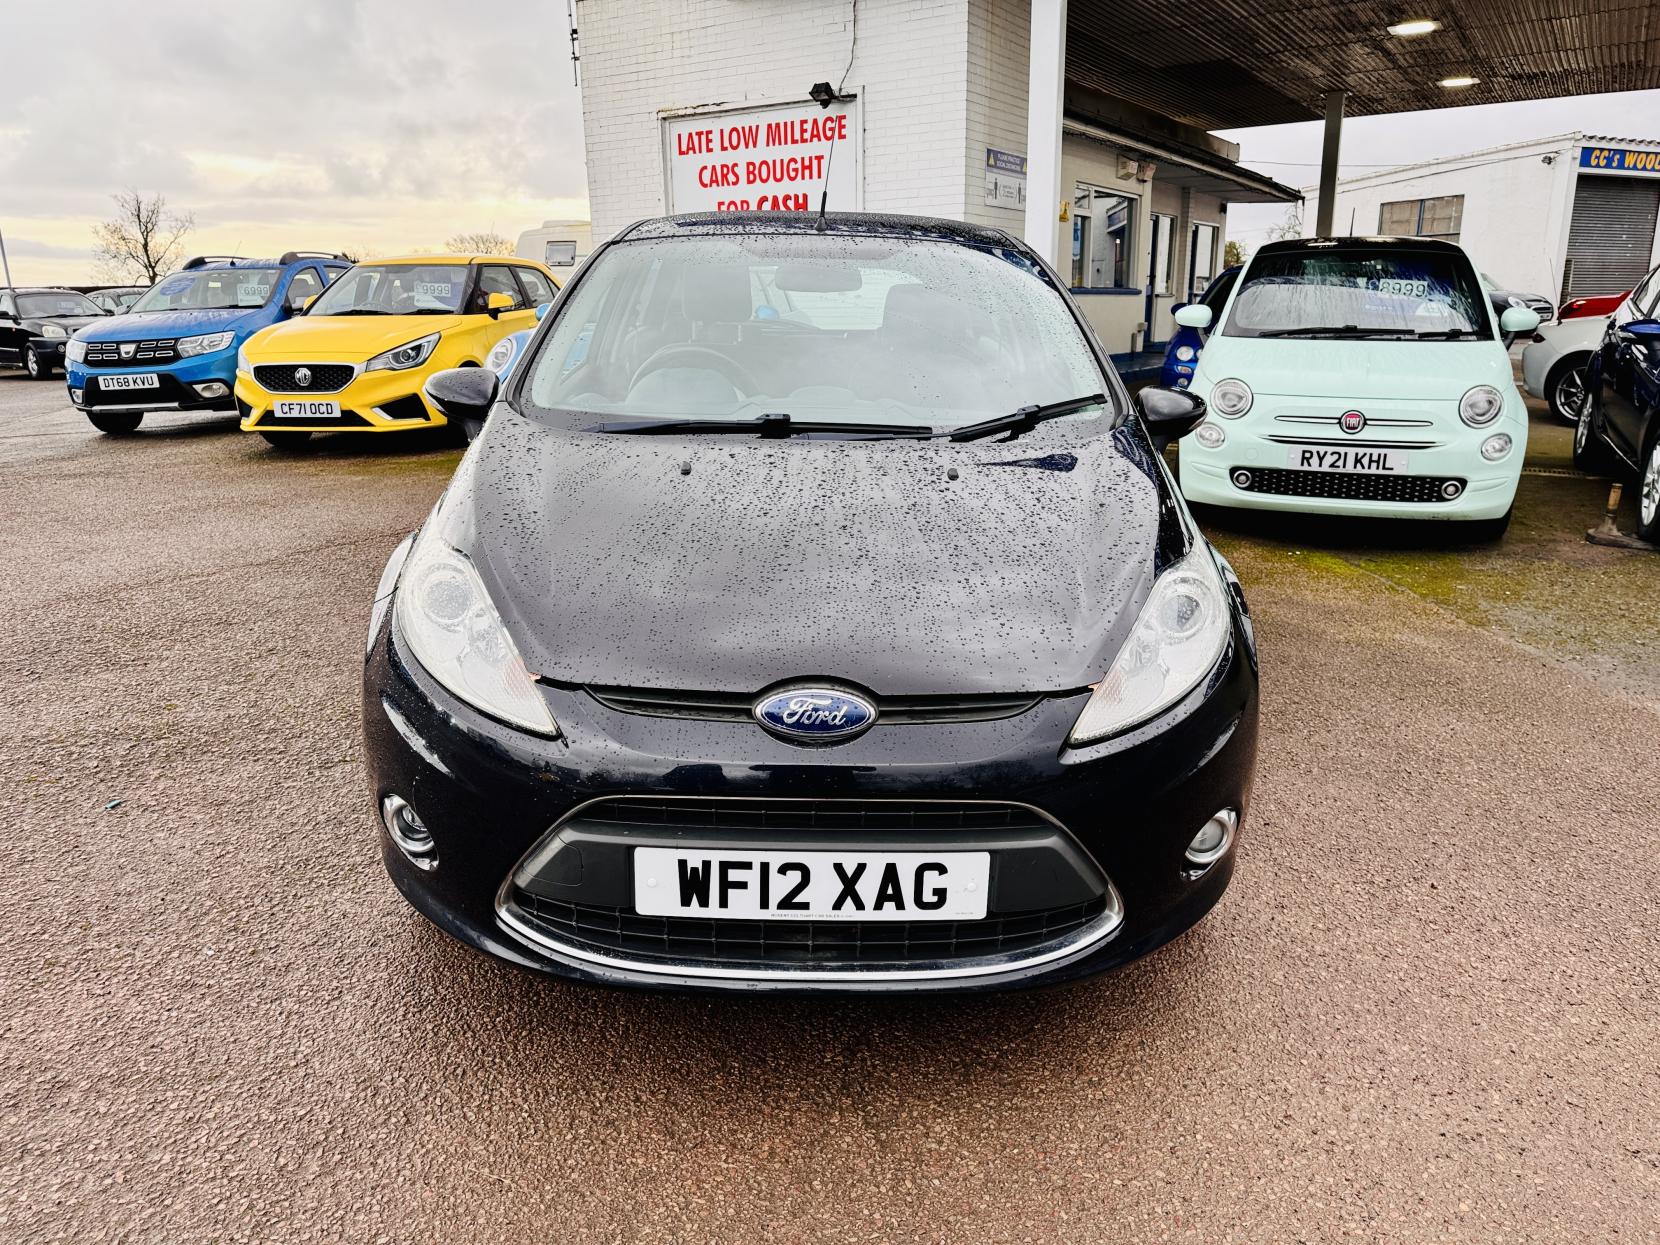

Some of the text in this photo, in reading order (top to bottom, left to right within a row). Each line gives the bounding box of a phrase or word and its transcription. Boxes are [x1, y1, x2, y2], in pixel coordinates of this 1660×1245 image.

[677, 114, 847, 156] LATE LOW MILEAGE
[1590, 149, 1620, 167] CC's
[698, 154, 825, 188] CARS BOUGHT
[756, 193, 808, 212] CASH
[102, 375, 154, 388] DT68 KVU
[280, 403, 307, 415] CF71
[1300, 450, 1395, 471] RY21 KHL
[782, 697, 848, 726] Ford
[677, 858, 949, 911] WF12 XAG
